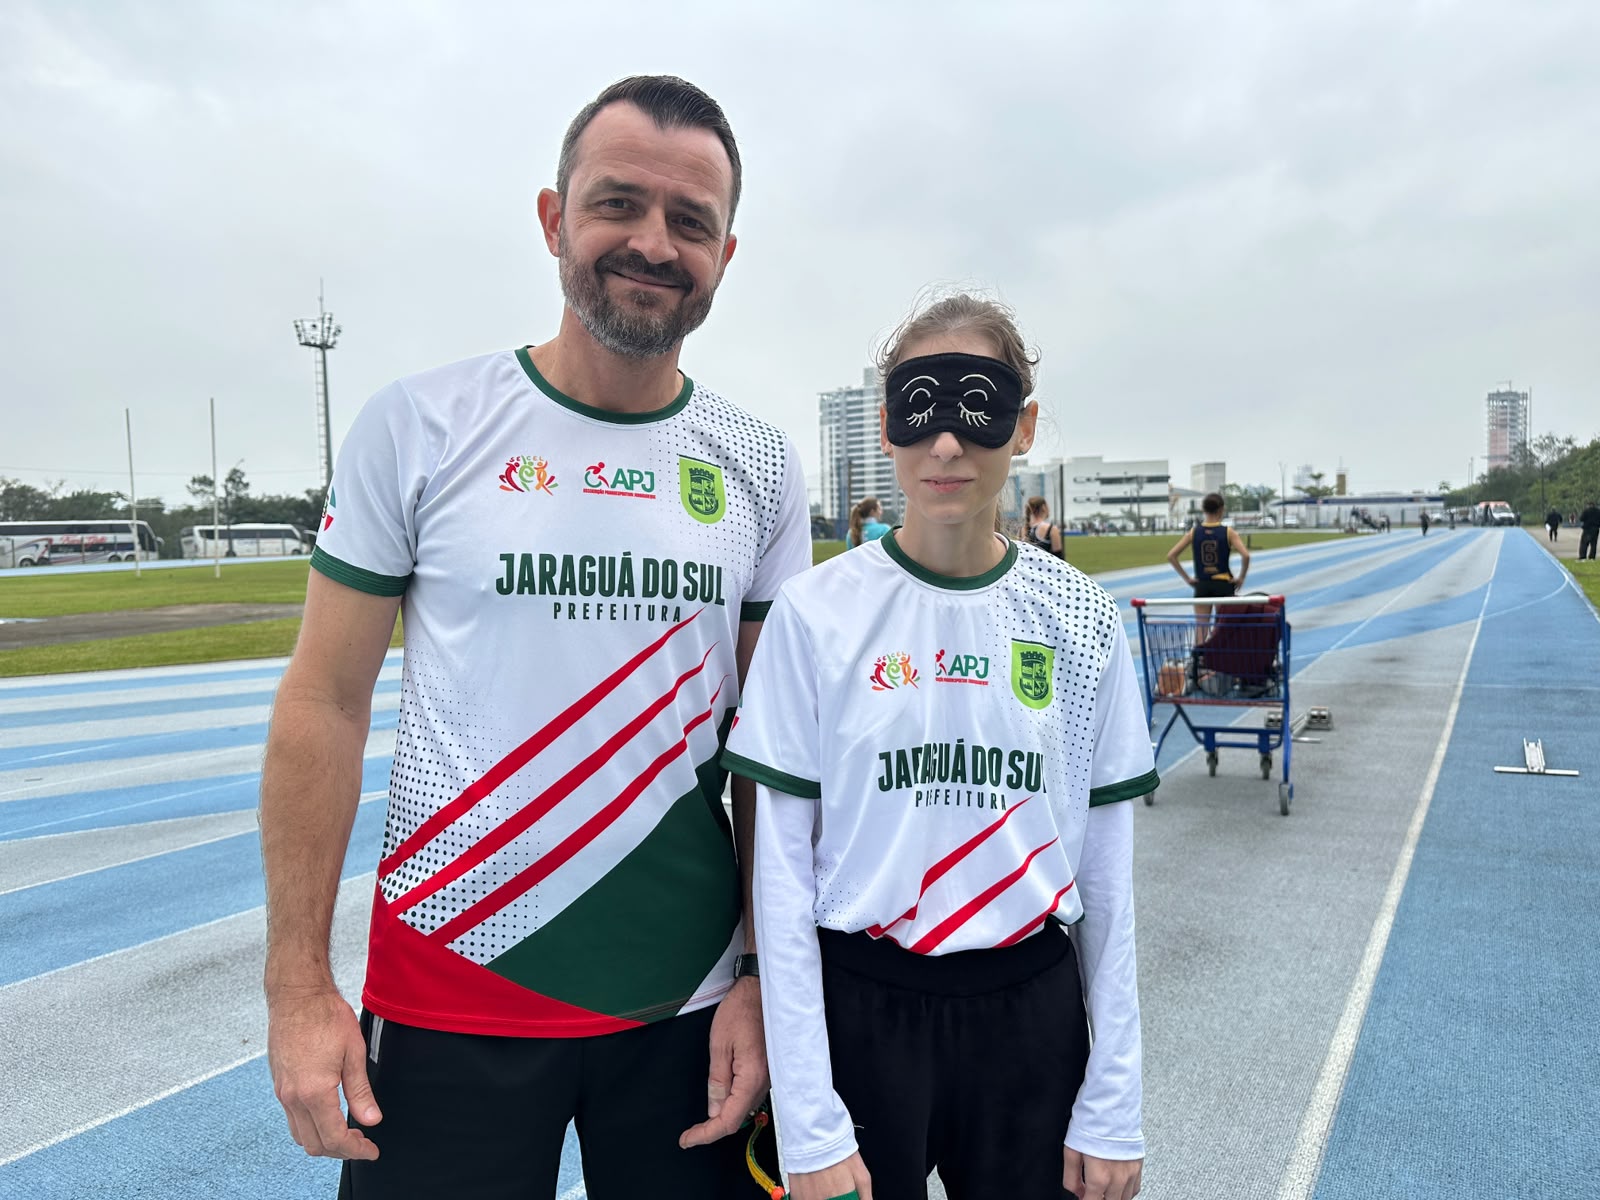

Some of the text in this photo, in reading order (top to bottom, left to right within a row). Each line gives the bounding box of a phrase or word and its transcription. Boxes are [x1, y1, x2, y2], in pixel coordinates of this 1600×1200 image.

[610, 468, 655, 493] APJ
[496, 551, 725, 607] JARAGUÁ DO SUL
[553, 602, 681, 623] PREFEITURA
[947, 654, 989, 679] APJ
[971, 745, 1003, 788] DO
[1006, 749, 1047, 794] SU
[915, 788, 1007, 811] PFEITURA
